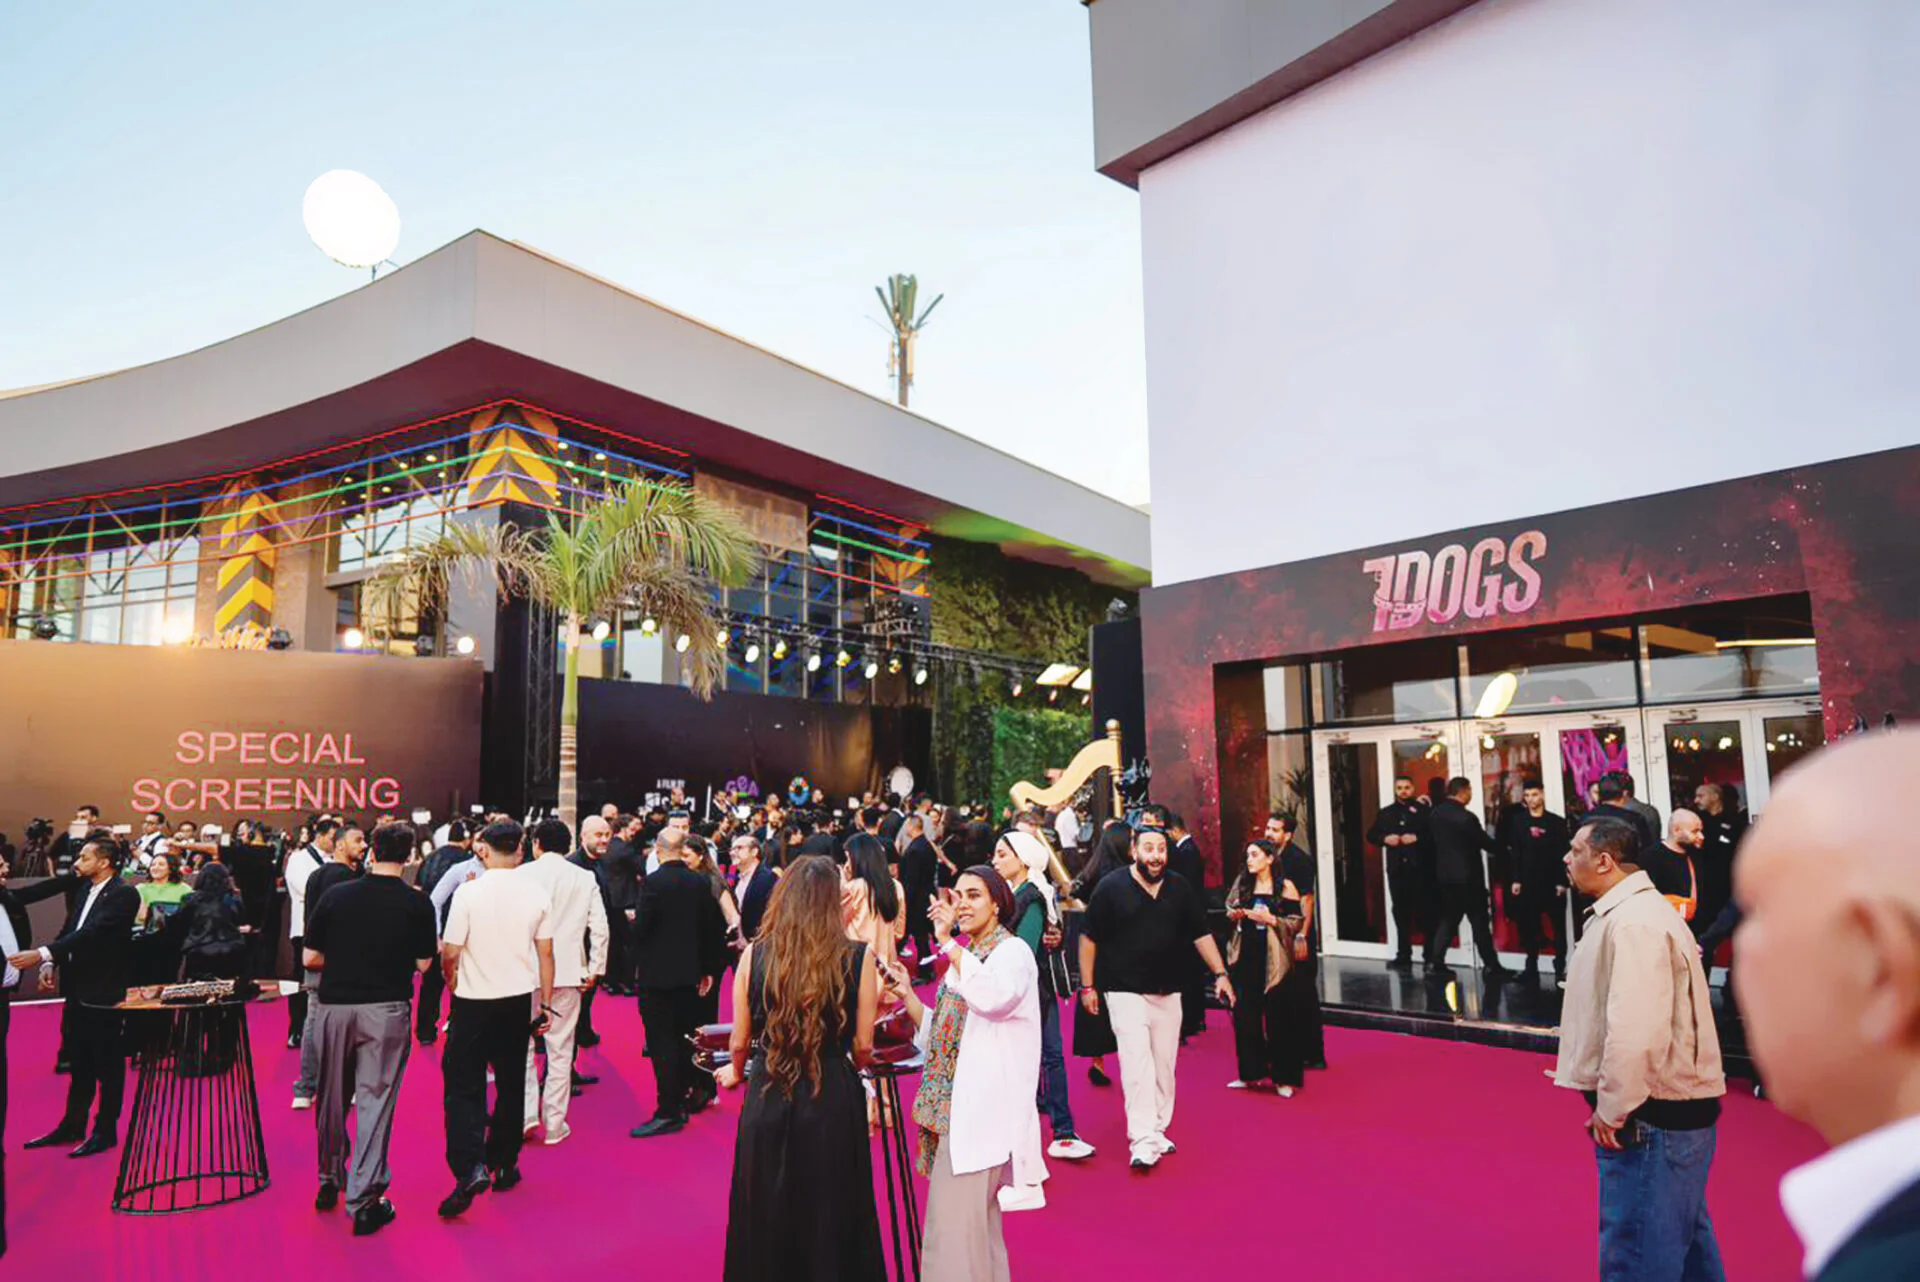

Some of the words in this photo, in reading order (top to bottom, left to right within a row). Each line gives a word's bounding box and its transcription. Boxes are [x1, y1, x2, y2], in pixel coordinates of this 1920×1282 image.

[1363, 530, 1547, 632] 7DOGS
[176, 731, 366, 765] SPECIAL
[131, 777, 401, 812] SCREENING
